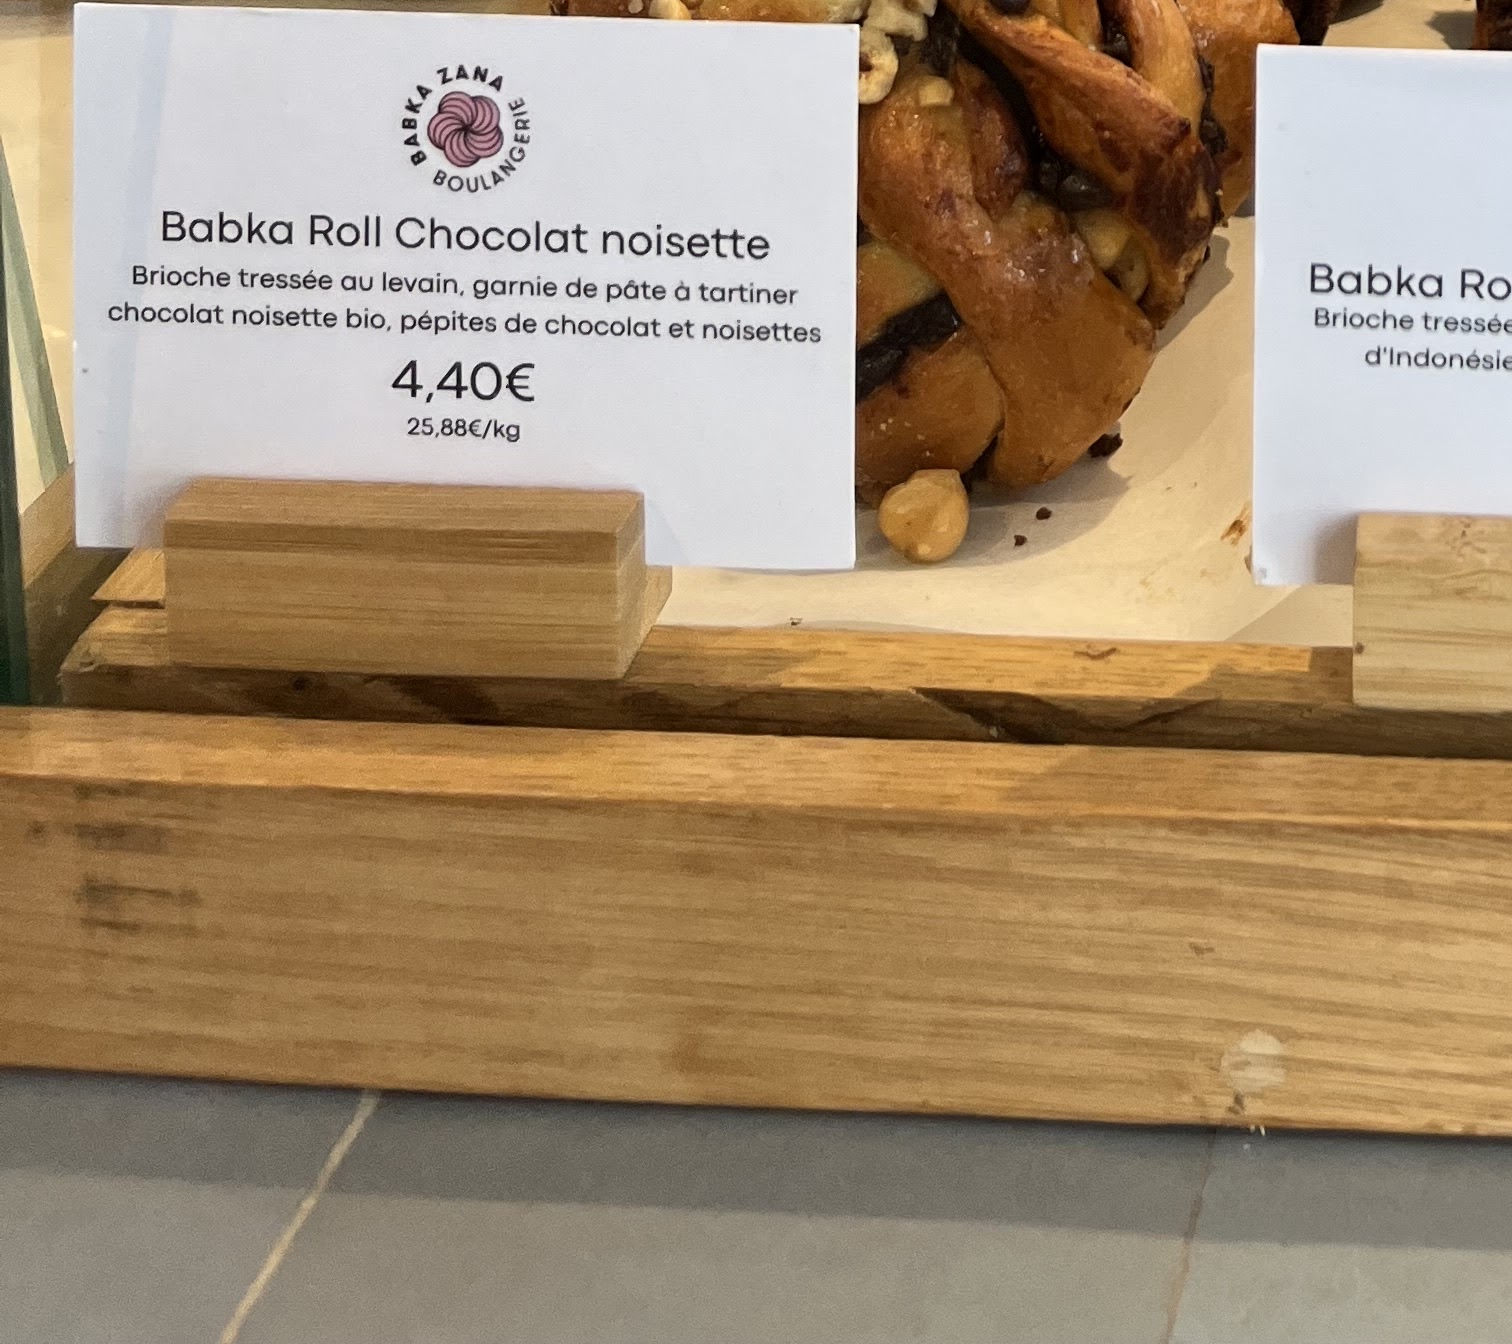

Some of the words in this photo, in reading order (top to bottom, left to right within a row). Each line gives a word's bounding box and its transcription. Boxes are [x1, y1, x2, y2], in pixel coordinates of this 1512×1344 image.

[402, 84, 433, 166] BABKA
[436, 64, 503, 92] ZANA
[433, 97, 531, 193] BOULANGERIE
[162, 210, 293, 245] Babka
[310, 213, 381, 248] Roll
[395, 216, 589, 254] Chocolat
[599, 224, 770, 261] noisette
[132, 265, 231, 289] Brioche
[237, 269, 333, 291] tressée
[341, 275, 373, 291] au
[382, 272, 464, 297] levain,
[473, 276, 558, 300] garnie
[565, 277, 598, 299] de
[606, 280, 667, 304] pâte
[674, 280, 690, 302] à
[698, 282, 799, 305] tartiner
[1310, 262, 1443, 300] Babka
[108, 301, 224, 324] chocolat
[232, 304, 338, 328] noisette
[346, 308, 392, 332] bio,
[401, 310, 497, 335] pépites
[504, 312, 537, 334] de
[544, 313, 661, 338] chocolat
[668, 319, 695, 339] et
[702, 319, 821, 344] noisettes
[1314, 307, 1414, 332] Brioche
[390, 360, 535, 405] 4,40€
[407, 417, 520, 443] 25,88€/kg
